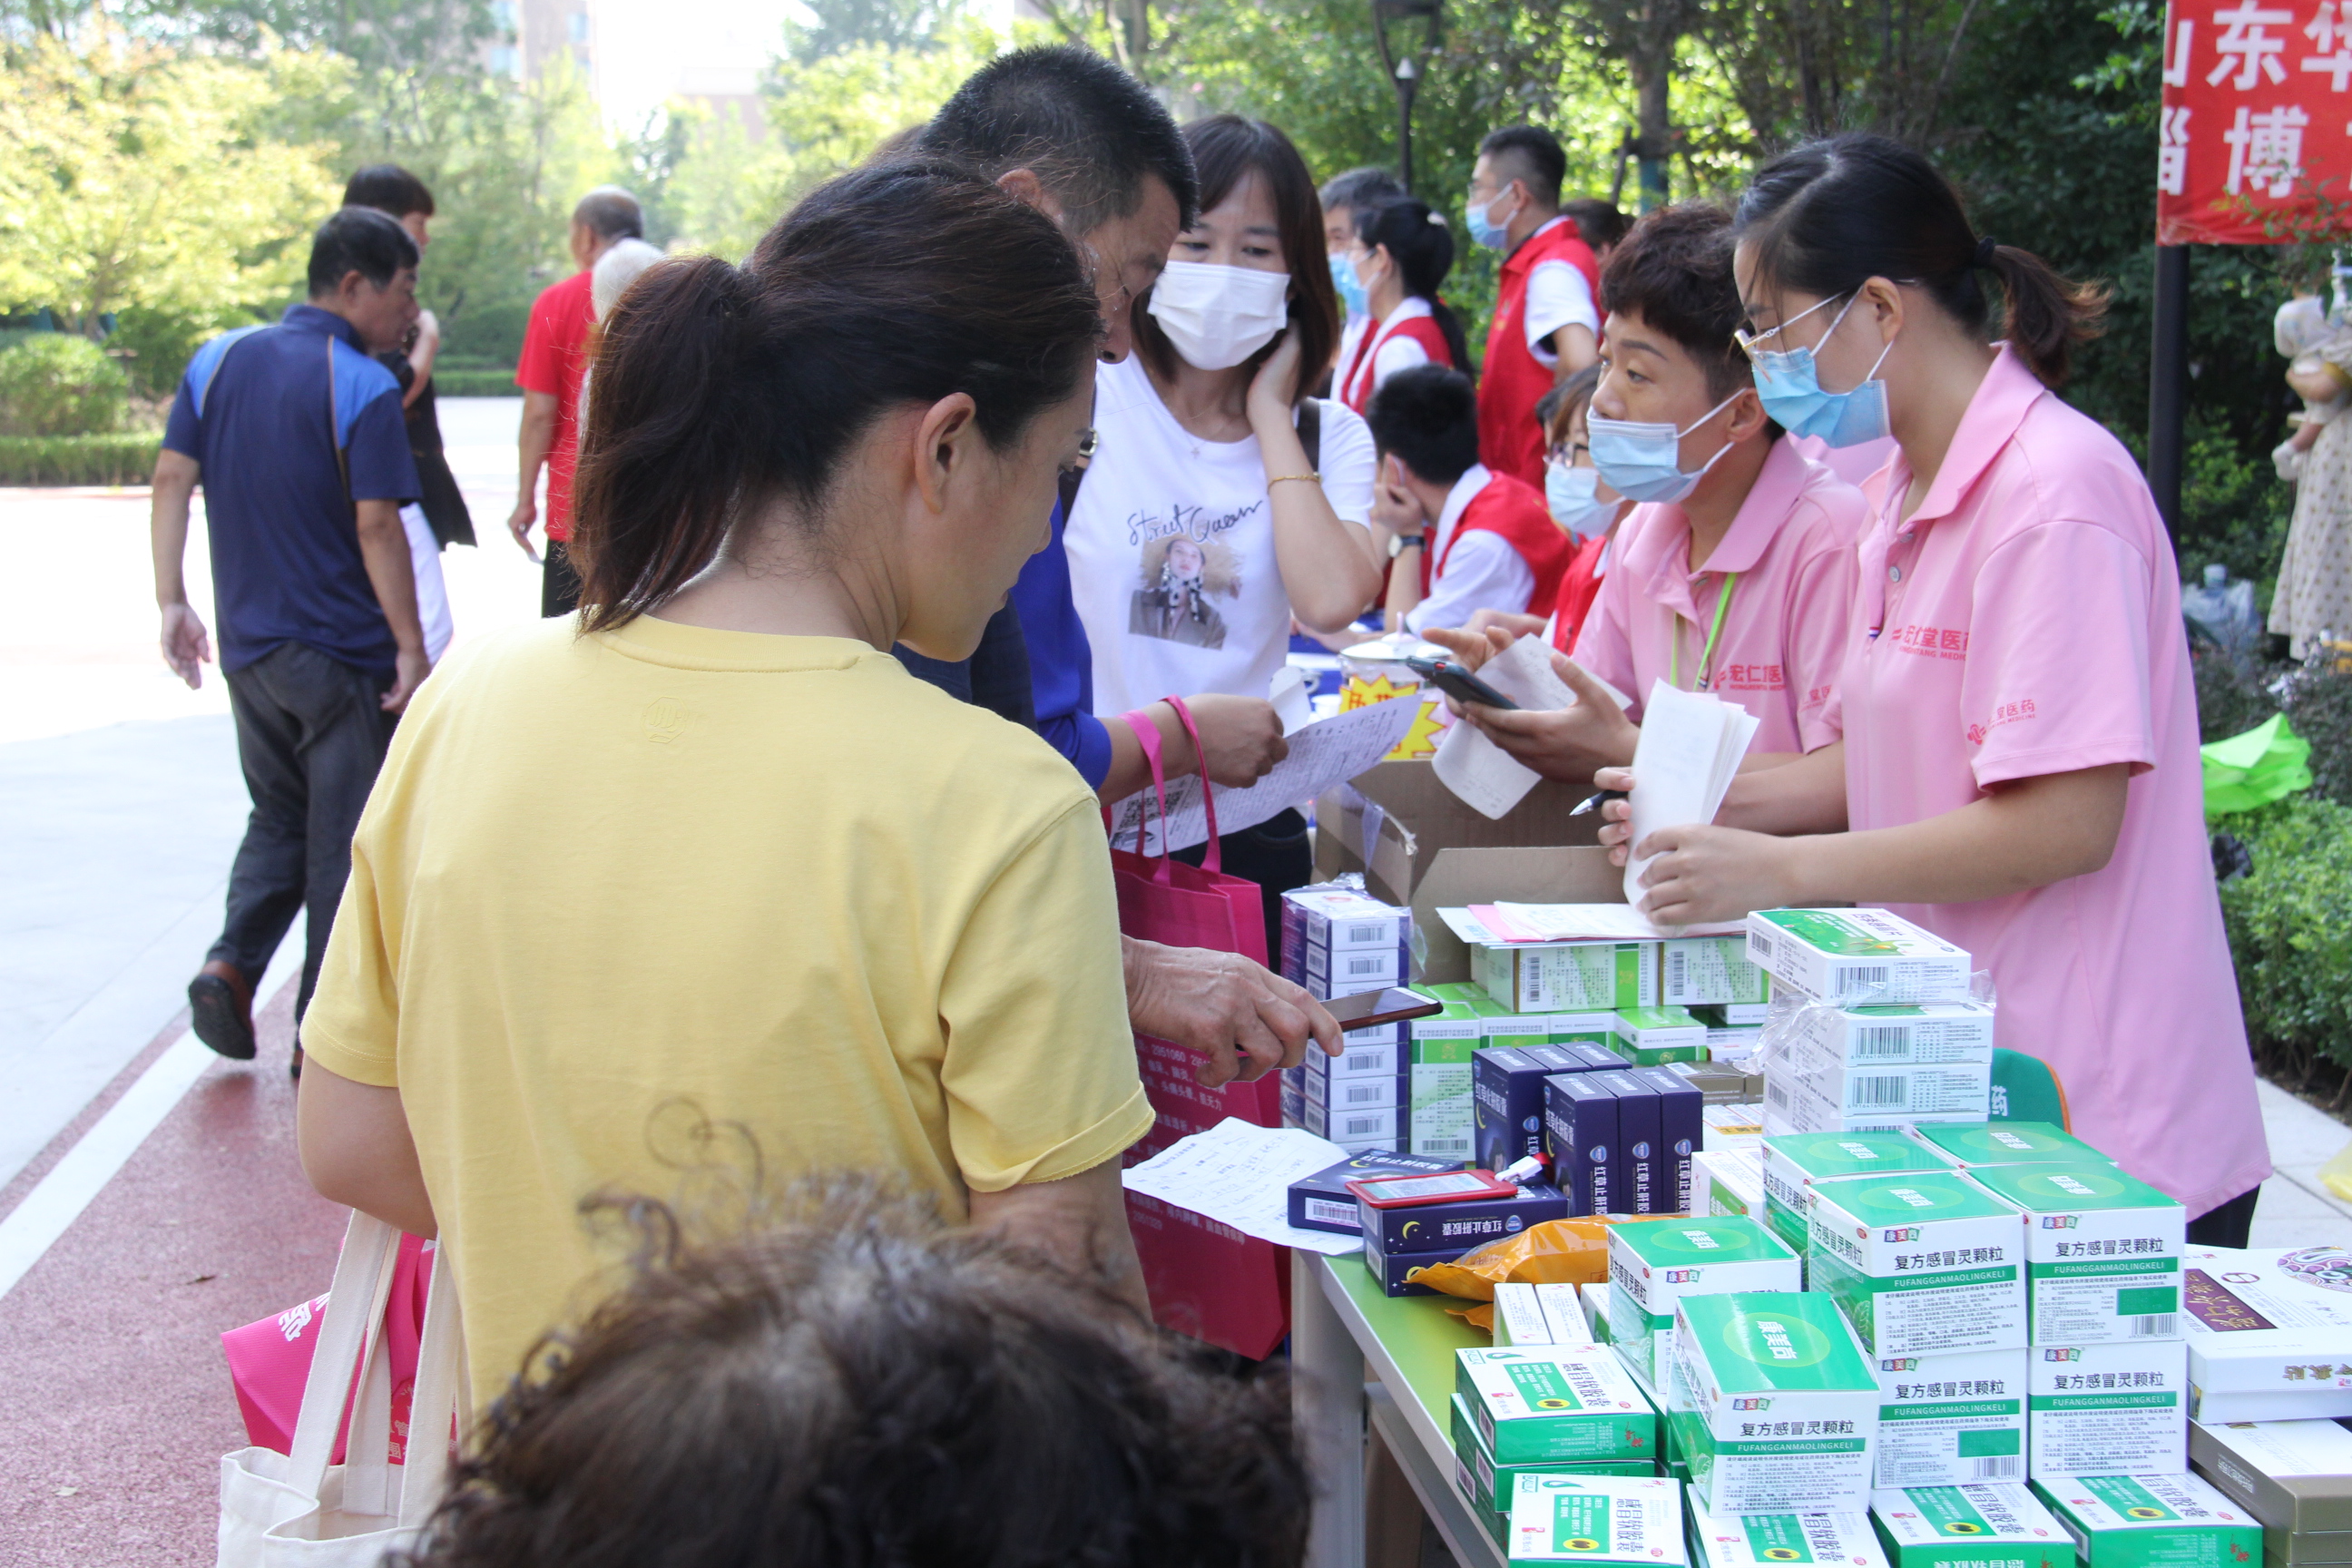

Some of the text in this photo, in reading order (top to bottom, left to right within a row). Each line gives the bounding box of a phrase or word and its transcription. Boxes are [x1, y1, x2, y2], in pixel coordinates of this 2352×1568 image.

[1127, 504, 1194, 545] Street
[2055, 1238, 2163, 1257] 复方感冒灵颗粒
[1895, 1246, 2004, 1270] 复方感冒灵颗粒
[2054, 1261, 2164, 1273] FUFANGGANMAOLINGKELI
[1894, 1270, 2005, 1287] FUFANGGANMAOLINGKELI
[1896, 1379, 2004, 1399] 复方感冒灵颗粒
[2053, 1371, 2164, 1390] 复方感冒灵颗粒
[2053, 1396, 2165, 1406] FUFANGGANMAOLINGKELI
[1894, 1404, 2005, 1416] FUFANGGANMAOLINGKELI
[1740, 1420, 1854, 1436] 复方感冒灵颗粒
[1738, 1441, 1853, 1452] FUFANGGANMAOLINGKELI
